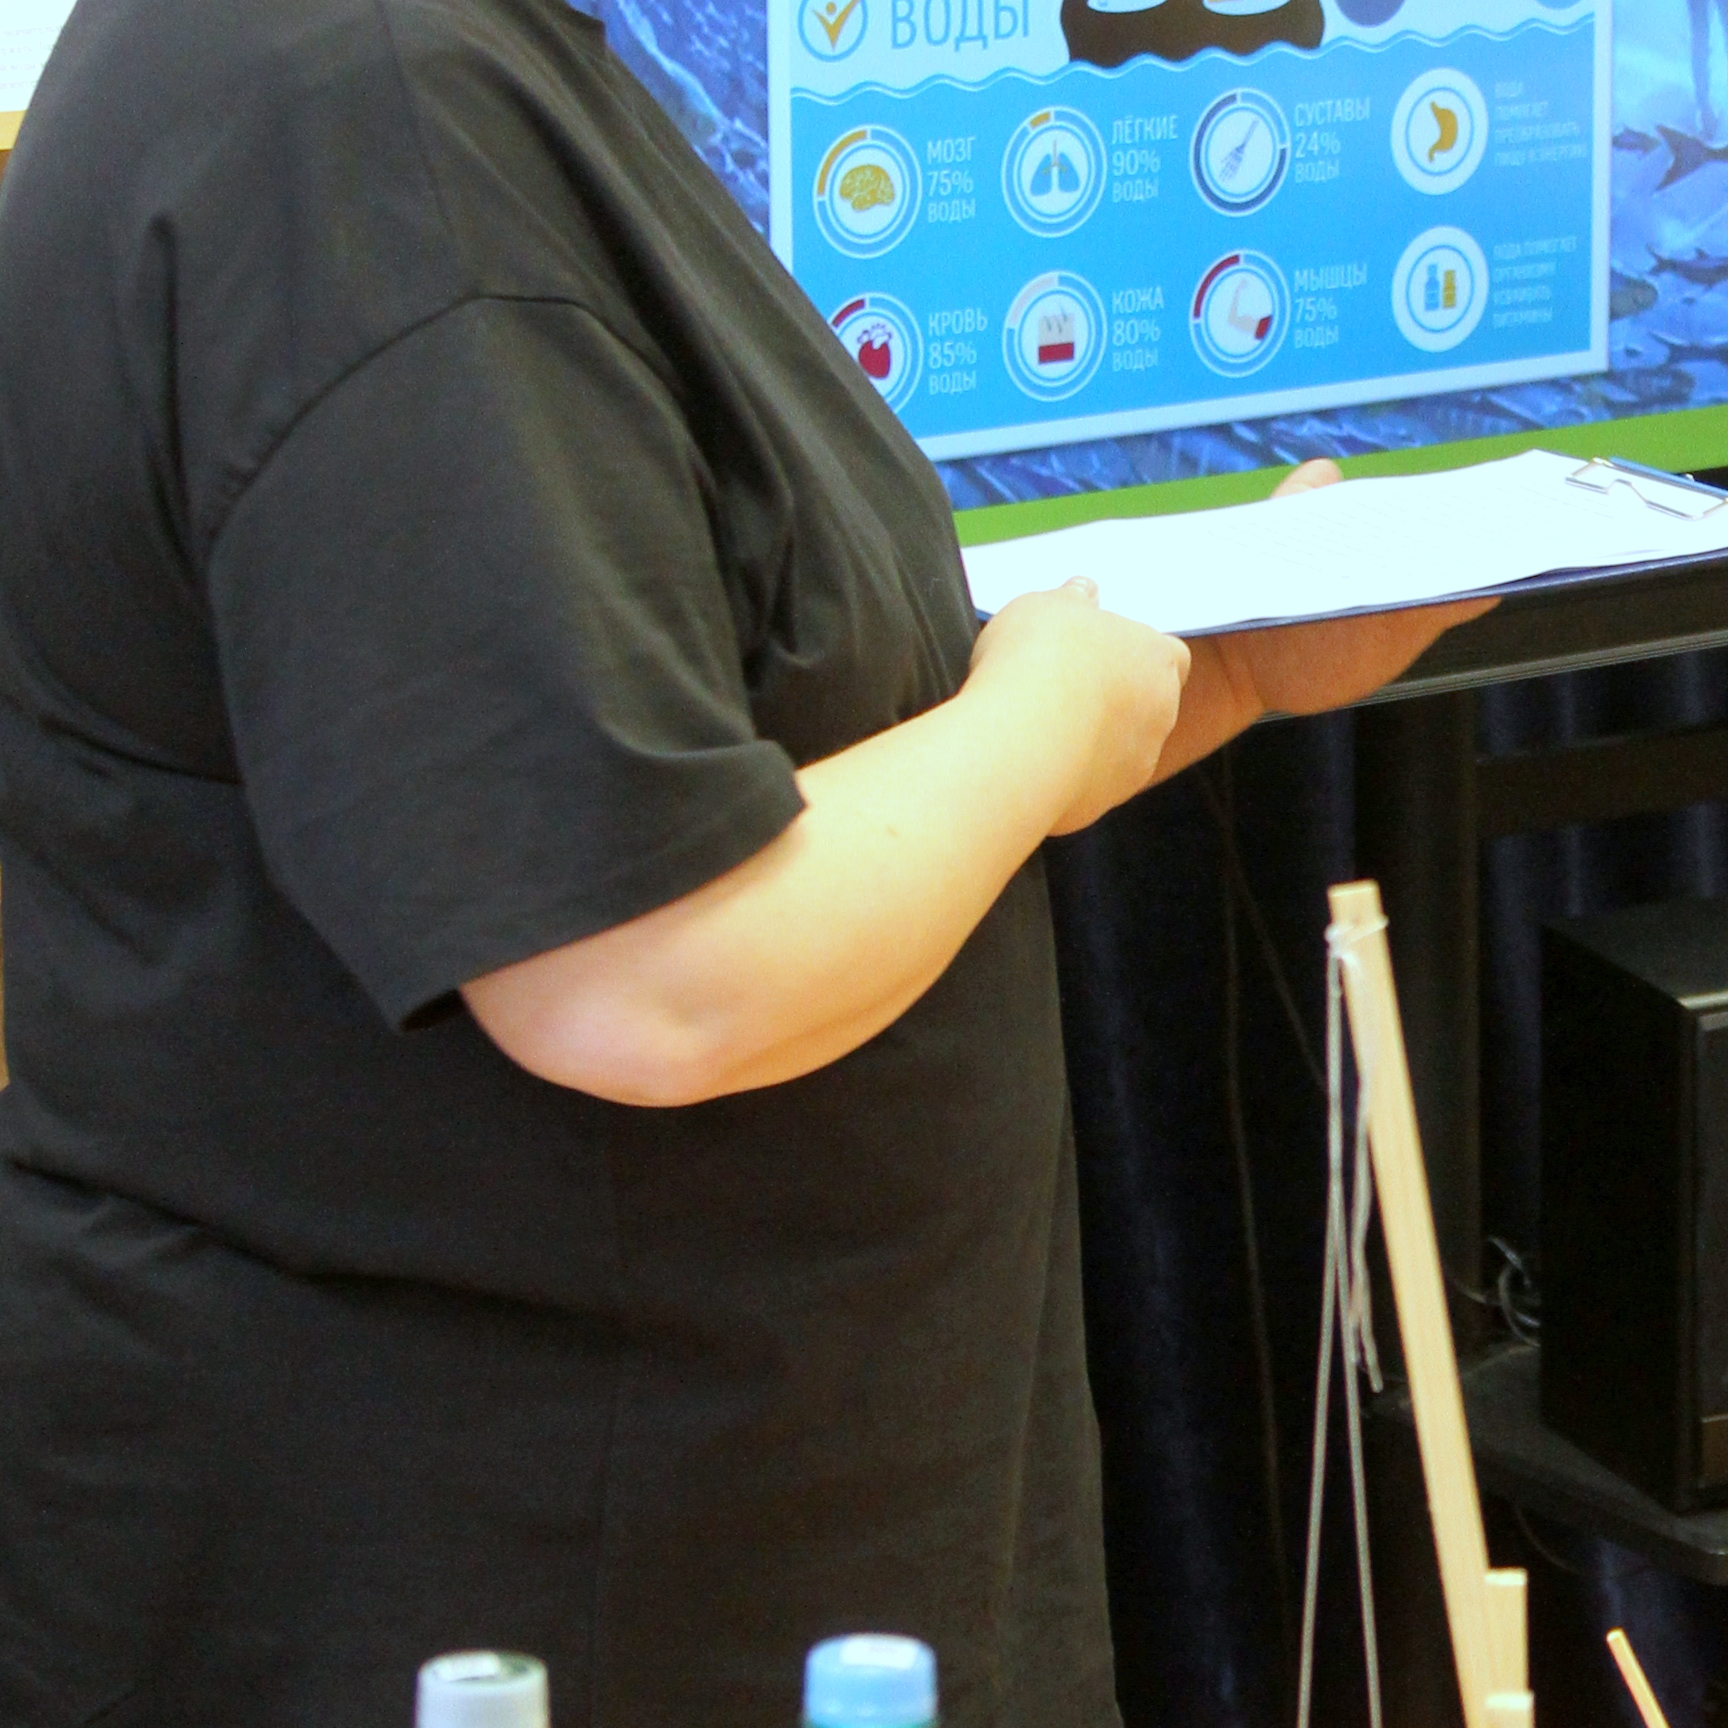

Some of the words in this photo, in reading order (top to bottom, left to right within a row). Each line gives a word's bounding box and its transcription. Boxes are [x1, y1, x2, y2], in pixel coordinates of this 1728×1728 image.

[1295, 96, 1370, 127] СУСТАВЫ
[1112, 115, 1179, 145] ЛЁГКИЕ
[927, 135, 976, 164] МОЗГ
[1295, 131, 1341, 159] 24%
[1112, 149, 1160, 176] 90%
[1295, 159, 1340, 183] ВОДЫ
[928, 169, 974, 198] 75%
[1113, 177, 1160, 203] ВОДЫ
[928, 198, 976, 223] ВОДЫ
[1294, 262, 1368, 293] МЫШЦЫ
[1112, 285, 1165, 314] КОЖА
[1295, 296, 1338, 323] 75%
[928, 308, 988, 337] КРОВЬ
[1112, 318, 1160, 346] 80%
[1295, 325, 1340, 349] ВОДЫ
[929, 339, 978, 370] 85%
[1113, 346, 1159, 372] ВОДЫ
[929, 369, 977, 396] ВОДЫ
